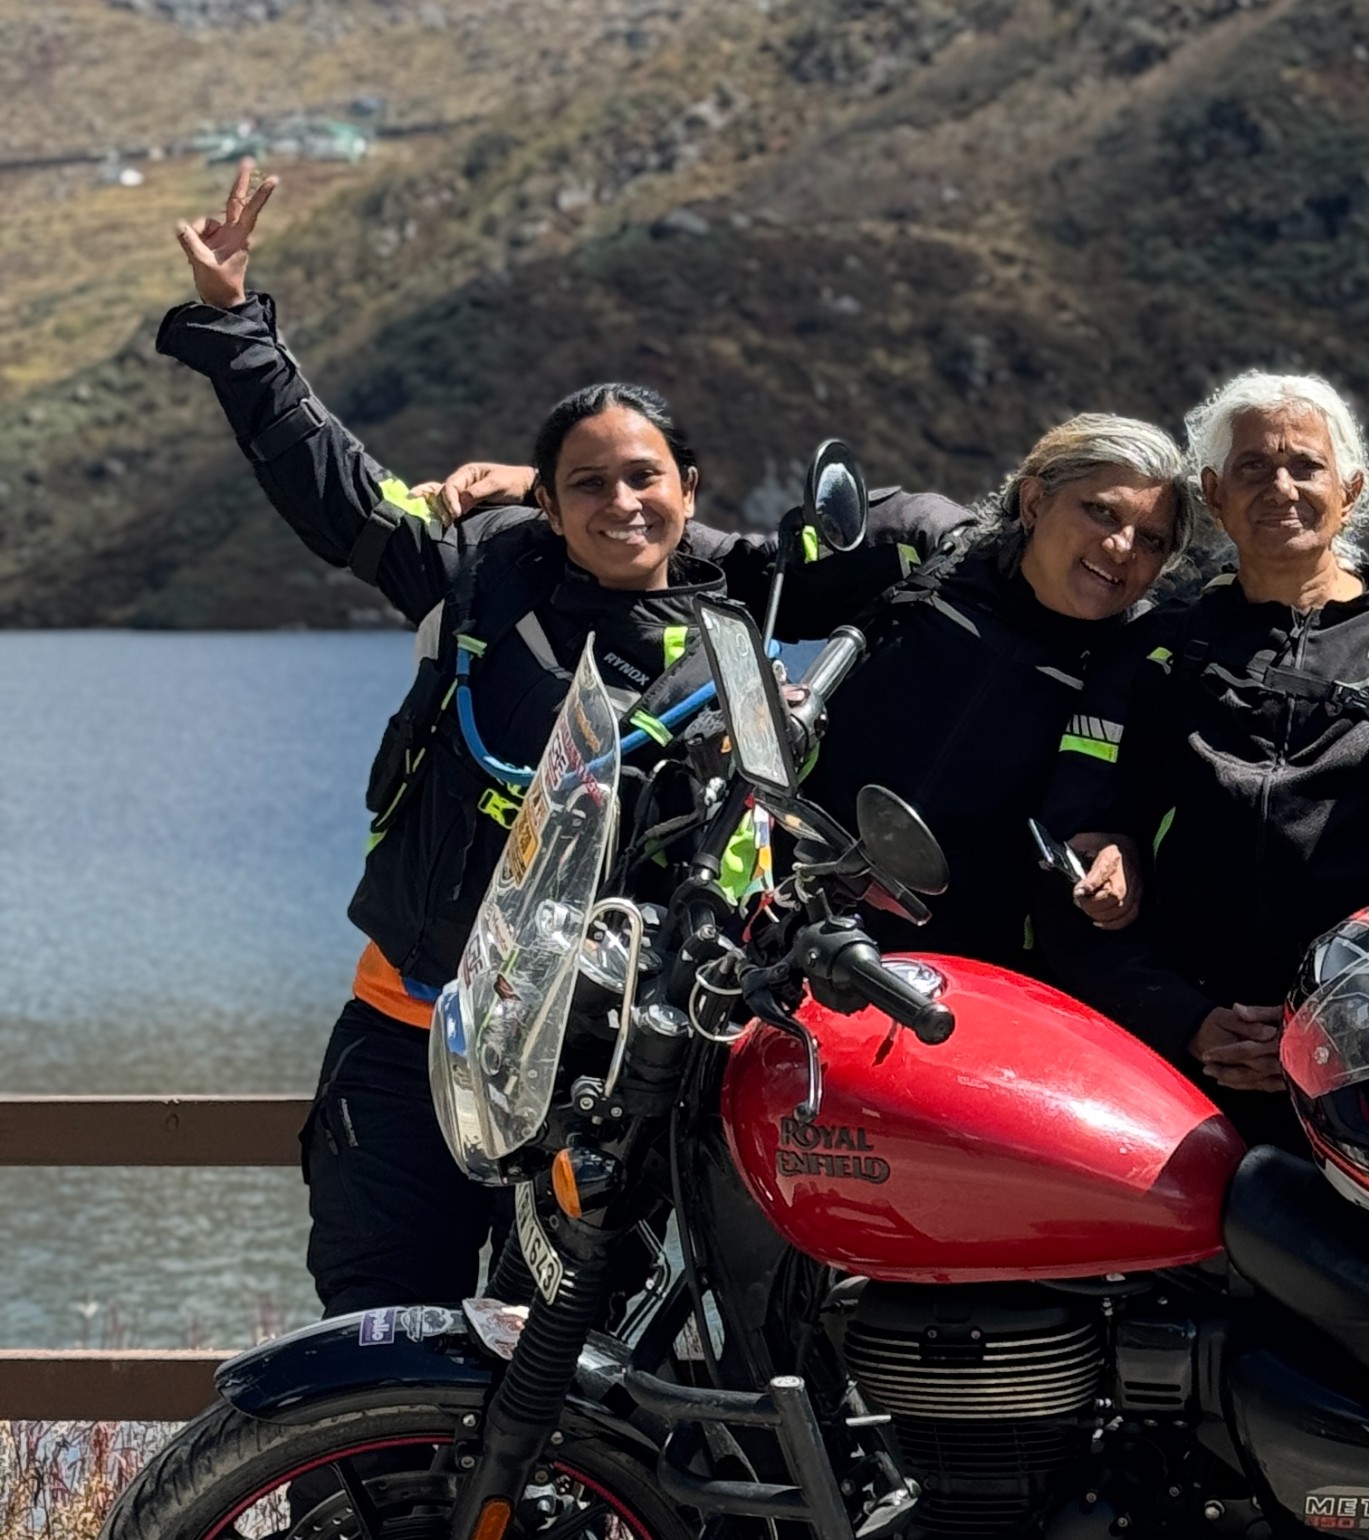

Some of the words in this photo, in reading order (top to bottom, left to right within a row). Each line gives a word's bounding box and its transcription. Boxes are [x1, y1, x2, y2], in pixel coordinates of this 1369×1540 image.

[603, 652, 650, 686] RYNOX
[781, 1116, 875, 1151] ROYAL
[776, 1149, 891, 1185] ENFIELD
